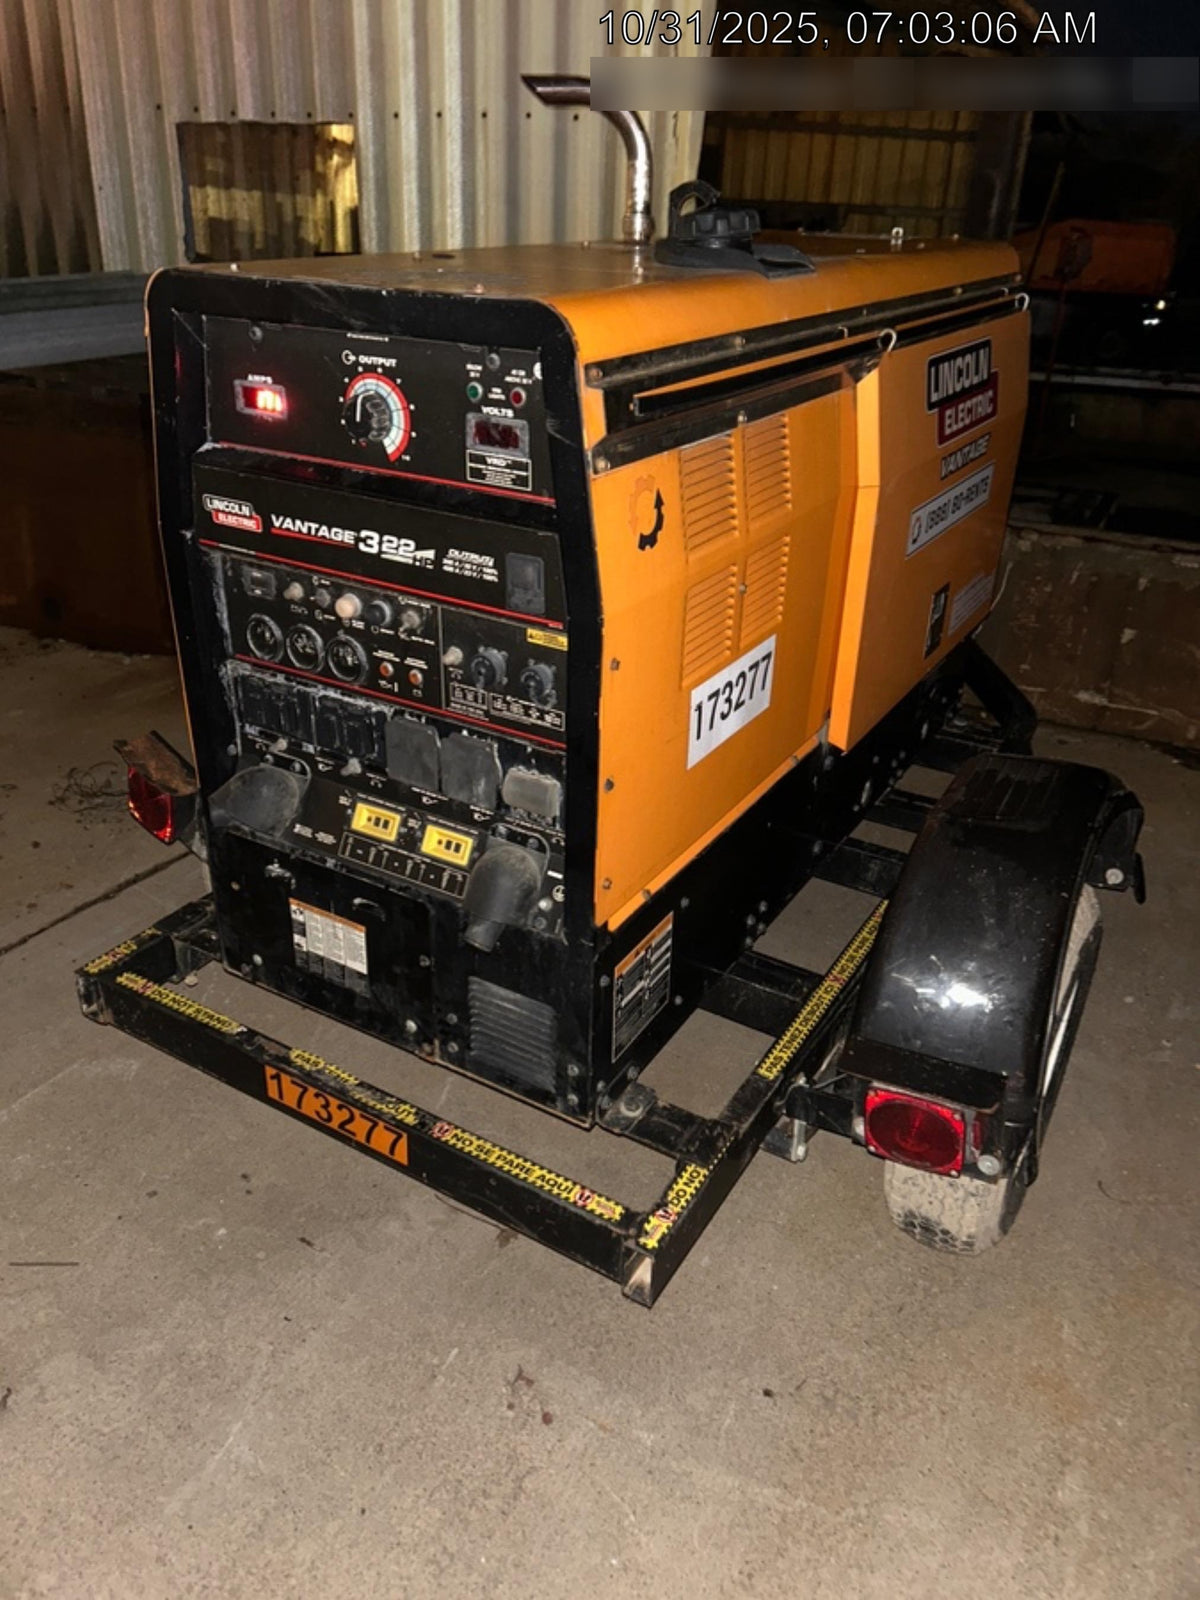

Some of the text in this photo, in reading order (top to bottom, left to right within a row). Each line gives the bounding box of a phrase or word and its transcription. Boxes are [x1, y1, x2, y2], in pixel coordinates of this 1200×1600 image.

[247, 374, 273, 384] AMPS
[359, 355, 397, 367] OUTPUT
[930, 346, 989, 403] LINCOLN
[481, 405, 514, 418] VOLTS
[944, 389, 994, 436] ELECTRIC
[206, 498, 250, 516] LINCOLN
[217, 513, 257, 529] ELECTRIC
[270, 513, 356, 544] VANTAGE
[358, 529, 416, 557] 322
[694, 651, 772, 741] 173277
[150, 988, 233, 1028] DO NOT STAND
[269, 1071, 403, 1157] 173277
[450, 1132, 574, 1195] NO SE PARE AQUI
[670, 1188, 687, 1208] DO
